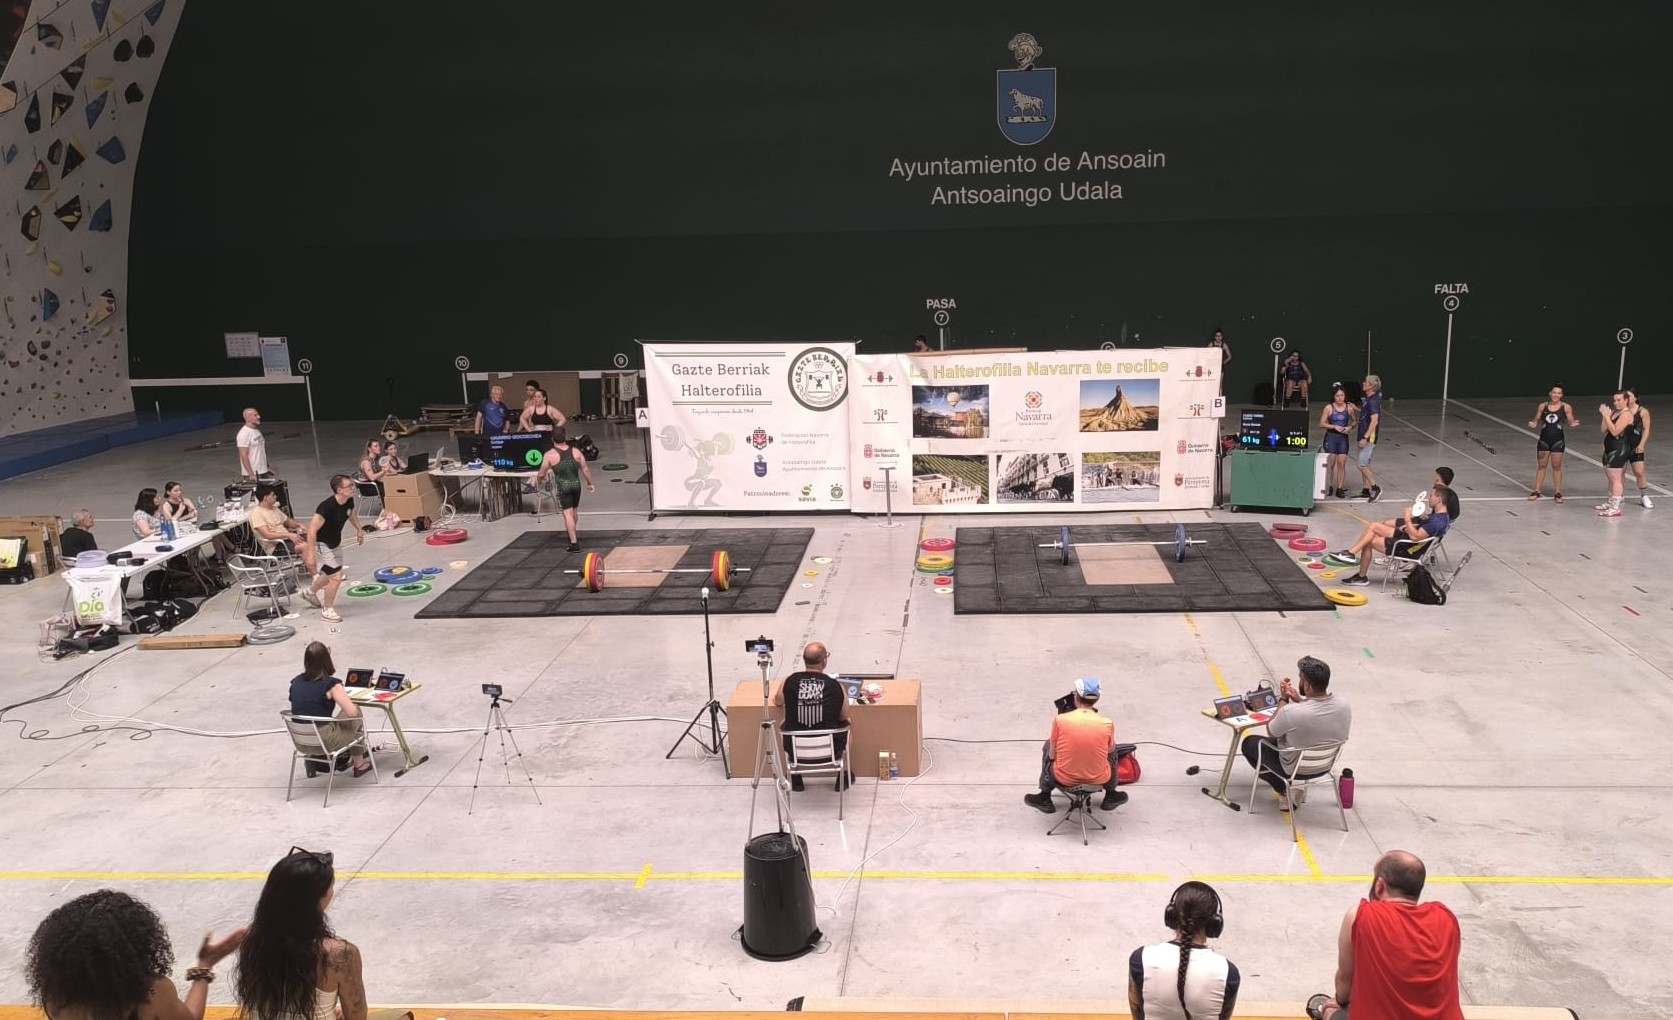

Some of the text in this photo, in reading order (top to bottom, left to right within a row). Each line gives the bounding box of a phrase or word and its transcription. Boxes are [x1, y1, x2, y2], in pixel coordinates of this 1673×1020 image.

[889, 149, 1166, 181] Ayuntamiento de Ansoain
[931, 181, 1123, 207] Antsoaingo Udala
[1434, 283, 1469, 294] FALTA
[926, 298, 957, 309] PASA
[1622, 332, 1628, 340] 3
[1275, 341, 1281, 349] 5
[302, 362, 309, 370] 11
[458, 359, 467, 367] 10
[671, 362, 770, 376] Gazte Berriak
[910, 358, 1169, 379] La Halterofilia Navarra te recibe
[681, 384, 763, 396] Halterofilia
[1214, 398, 1223, 408] B
[638, 410, 648, 419] A
[1015, 411, 1052, 421] Navarra
[1286, 436, 1307, 445] 1:00
[799, 682, 825, 691] SHOW
[798, 690, 823, 700] DOWN
